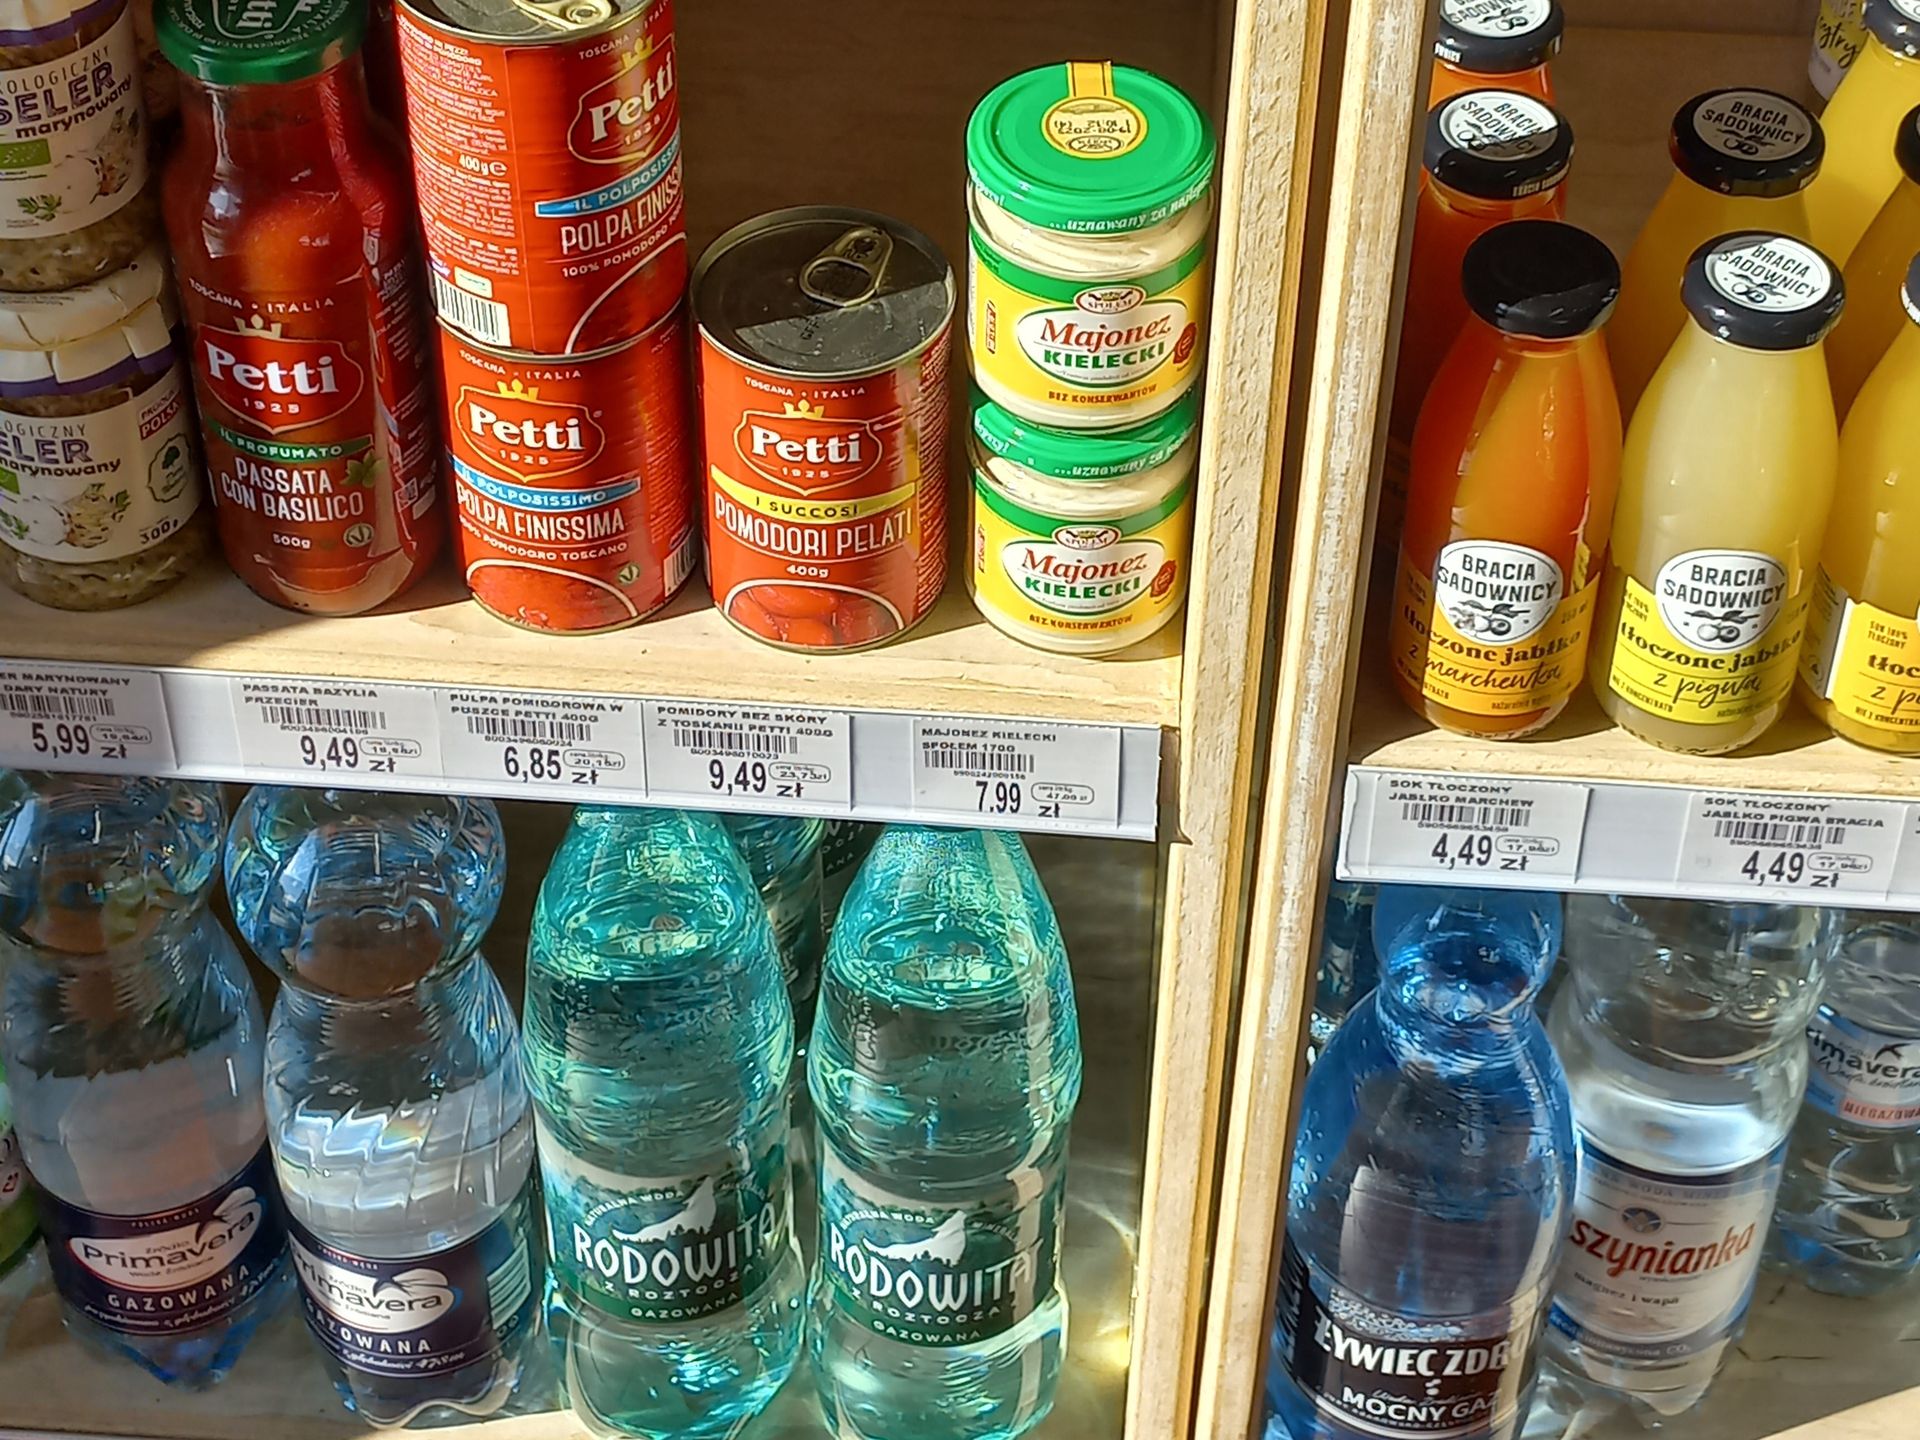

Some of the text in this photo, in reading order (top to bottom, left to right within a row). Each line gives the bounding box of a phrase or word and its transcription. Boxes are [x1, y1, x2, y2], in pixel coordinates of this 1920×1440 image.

[579, 33, 631, 61] TOSCANA
[15, 74, 133, 139] marynowany
[589, 53, 674, 143] Petti
[1460, 100, 1541, 154] SADOWNICY
[1494, 102, 1545, 136] BRACIA
[1701, 108, 1806, 146] SADOWNICY
[1730, 101, 1788, 126] BRACIA
[572, 198, 589, 211] IL
[561, 211, 633, 255] POLPA
[562, 223, 668, 278] 100% POMODORO
[1750, 245, 1811, 279] BRACIA
[1718, 251, 1821, 299] SADOWNICY
[189, 279, 334, 313] TOSCANA ITALIA
[1040, 314, 1172, 353] Majonez
[204, 340, 339, 395] Petti
[459, 350, 581, 380] TOSCANA ITALIA
[1044, 341, 1164, 370] KIELECKI
[744, 376, 866, 399] TOSCANA ITALIA
[244, 398, 300, 414] 1925
[0, 421, 86, 439] OGICZNY
[468, 402, 585, 451] Petti
[237, 437, 342, 459] PROFUMATO
[500, 449, 549, 466] 1925
[750, 424, 862, 464] Petti
[235, 457, 333, 494] PASSATA
[220, 472, 364, 522] CON BASILICO
[478, 477, 607, 507] POLPOSISSIMO
[455, 479, 625, 542] POLPA FINISSIMA
[756, 496, 859, 518] I SUCCOSI
[714, 491, 912, 556] POMODORI PELATI
[273, 533, 311, 549] 500g
[560, 542, 628, 561] TOSCANO
[786, 563, 829, 578] 400g
[1022, 547, 1148, 584] Majonez
[1462, 554, 1536, 581] BRACIA
[1690, 564, 1766, 587] BRACIA
[1024, 576, 1140, 599] KIELECKI
[1437, 566, 1557, 603] SADOWNICY
[1663, 578, 1786, 609] SADOWNICY
[1500, 631, 1581, 665] jabłko
[1621, 621, 1801, 673] tłoczone jabłko
[4, 685, 43, 693] DARY
[22, 673, 131, 686] MARYNOWANY
[243, 684, 378, 698] PASSATA BAZYLIA
[1653, 673, 1667, 688] z
[1870, 686, 1886, 701] z
[450, 694, 498, 704] PULPA
[502, 697, 607, 711] POMIDOROWA
[451, 706, 599, 722] PUSZCE PETTI 400G
[657, 706, 737, 718] POMIDORY
[742, 712, 769, 721] BEZ
[32, 722, 90, 759] 5,99
[672, 719, 743, 731] TOSKANII
[750, 724, 791, 734] PETTI
[921, 728, 1056, 742] MAJONEZ KIELECKI
[100, 744, 128, 759] zł
[300, 735, 358, 771] 9,49
[369, 757, 396, 773] zł
[504, 746, 562, 783] 6,85
[572, 769, 599, 784] zł
[709, 759, 767, 796] 9,49
[776, 782, 804, 797] zł
[1390, 780, 1513, 793] SOK TŁOCZONY
[976, 780, 1021, 814] 7.99
[1038, 803, 1060, 818] zł
[1455, 797, 1534, 807] MARCHEW
[1704, 798, 1830, 812] SOK TŁOCZONY
[1769, 814, 1821, 824] PIGWA
[1826, 817, 1884, 827] BRACIA
[1432, 833, 1492, 870] 4,49
[1500, 855, 1529, 871] zł
[1742, 850, 1804, 886] 4,49
[1810, 873, 1839, 888] zł
[584, 1190, 685, 1228] NATURALNA WODA
[892, 1212, 935, 1224] WODA
[82, 1210, 256, 1269] Primavera
[573, 1202, 776, 1287] RODOWITA
[831, 1222, 1031, 1312] RODOWITA
[107, 1264, 250, 1311] GAZOWANA
[605, 1264, 752, 1300] Z ROZTOCZA
[630, 1293, 738, 1318] GAZOWANA
[852, 1287, 1000, 1324] Z ROZTOCZA
[872, 1320, 982, 1342] GAZOWANA
[1342, 1387, 1449, 1422] MOCNY
